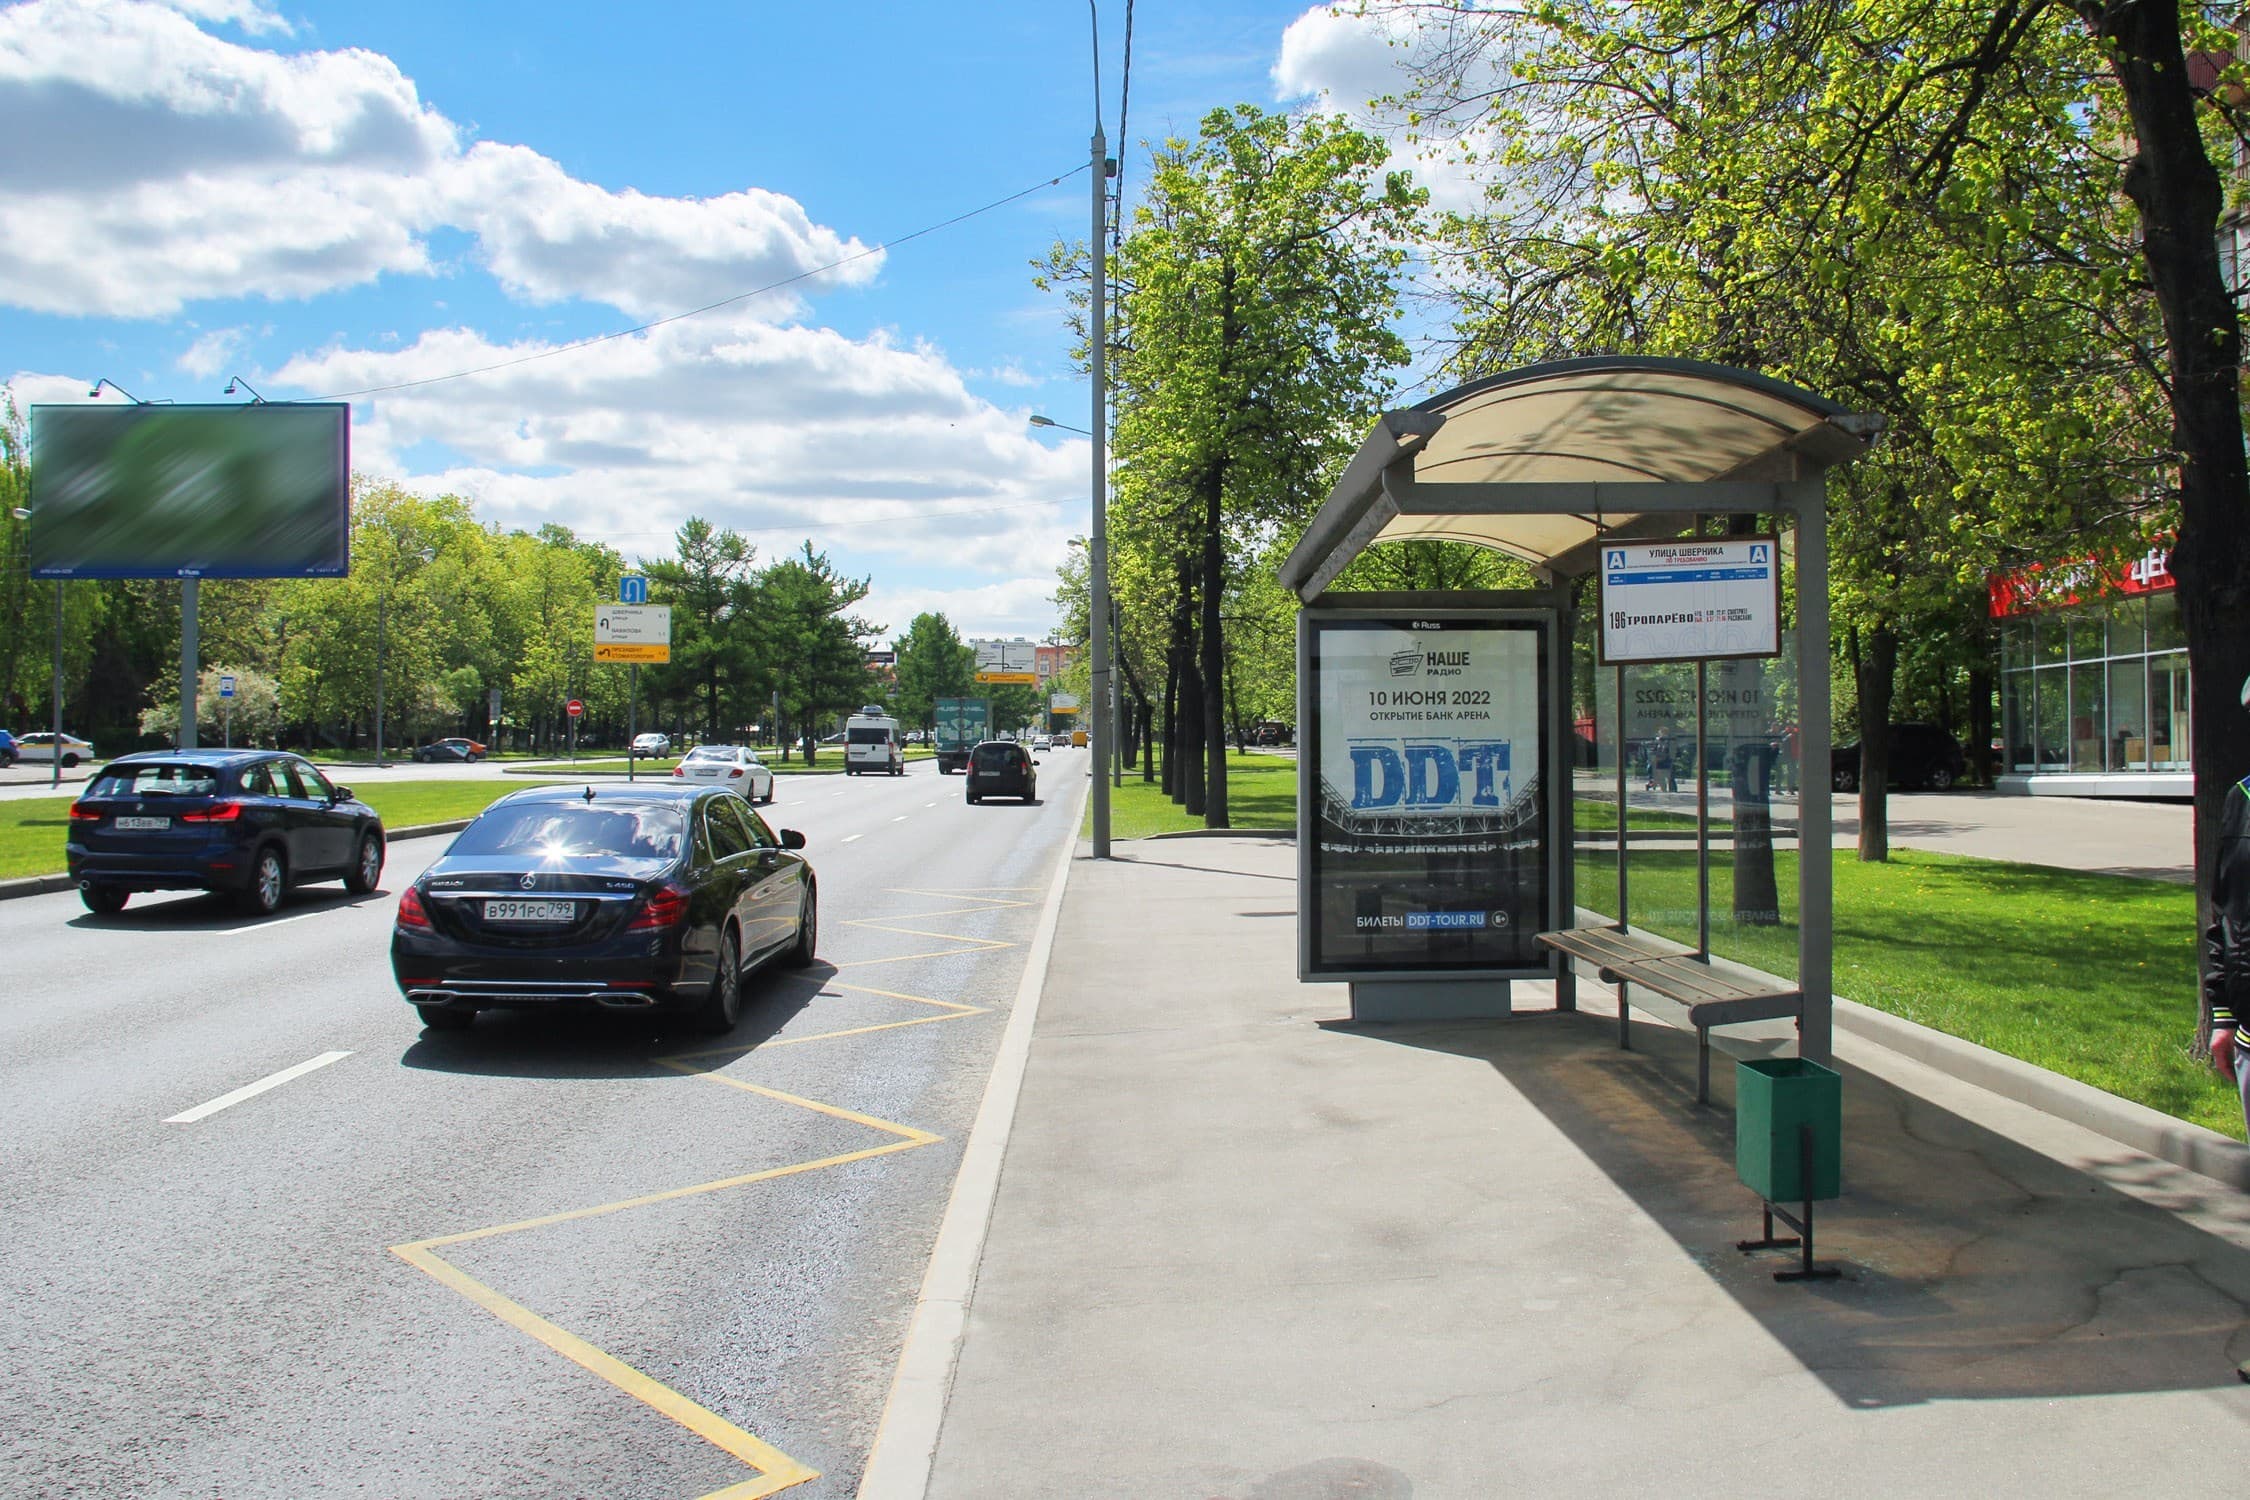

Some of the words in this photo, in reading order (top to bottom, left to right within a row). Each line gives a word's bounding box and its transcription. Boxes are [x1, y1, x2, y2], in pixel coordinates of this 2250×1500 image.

[1649, 549, 1678, 558] УЛИЦА
[1680, 547, 1724, 557] ШВЕРНИКА
[1421, 621, 1441, 629] Russ
[1609, 611, 1626, 630] 196
[1627, 612, 1694, 625] ТРОПАРЁВО
[1427, 652, 1470, 666] НАШЕ
[1427, 668, 1462, 676] РАДИО
[1369, 691, 1387, 705] 10
[1392, 691, 1446, 705] ИЮНЯ
[1452, 690, 1491, 705] 2022
[1370, 711, 1424, 721] ОТКРЫТИЕ
[1426, 711, 1453, 720] БАНК
[1456, 711, 1490, 720] АРЕНА
[1349, 740, 1511, 810] DDT
[1356, 916, 1403, 928] БИЛЕТЫ
[1408, 914, 1485, 927] DDT-TOUR.RU
